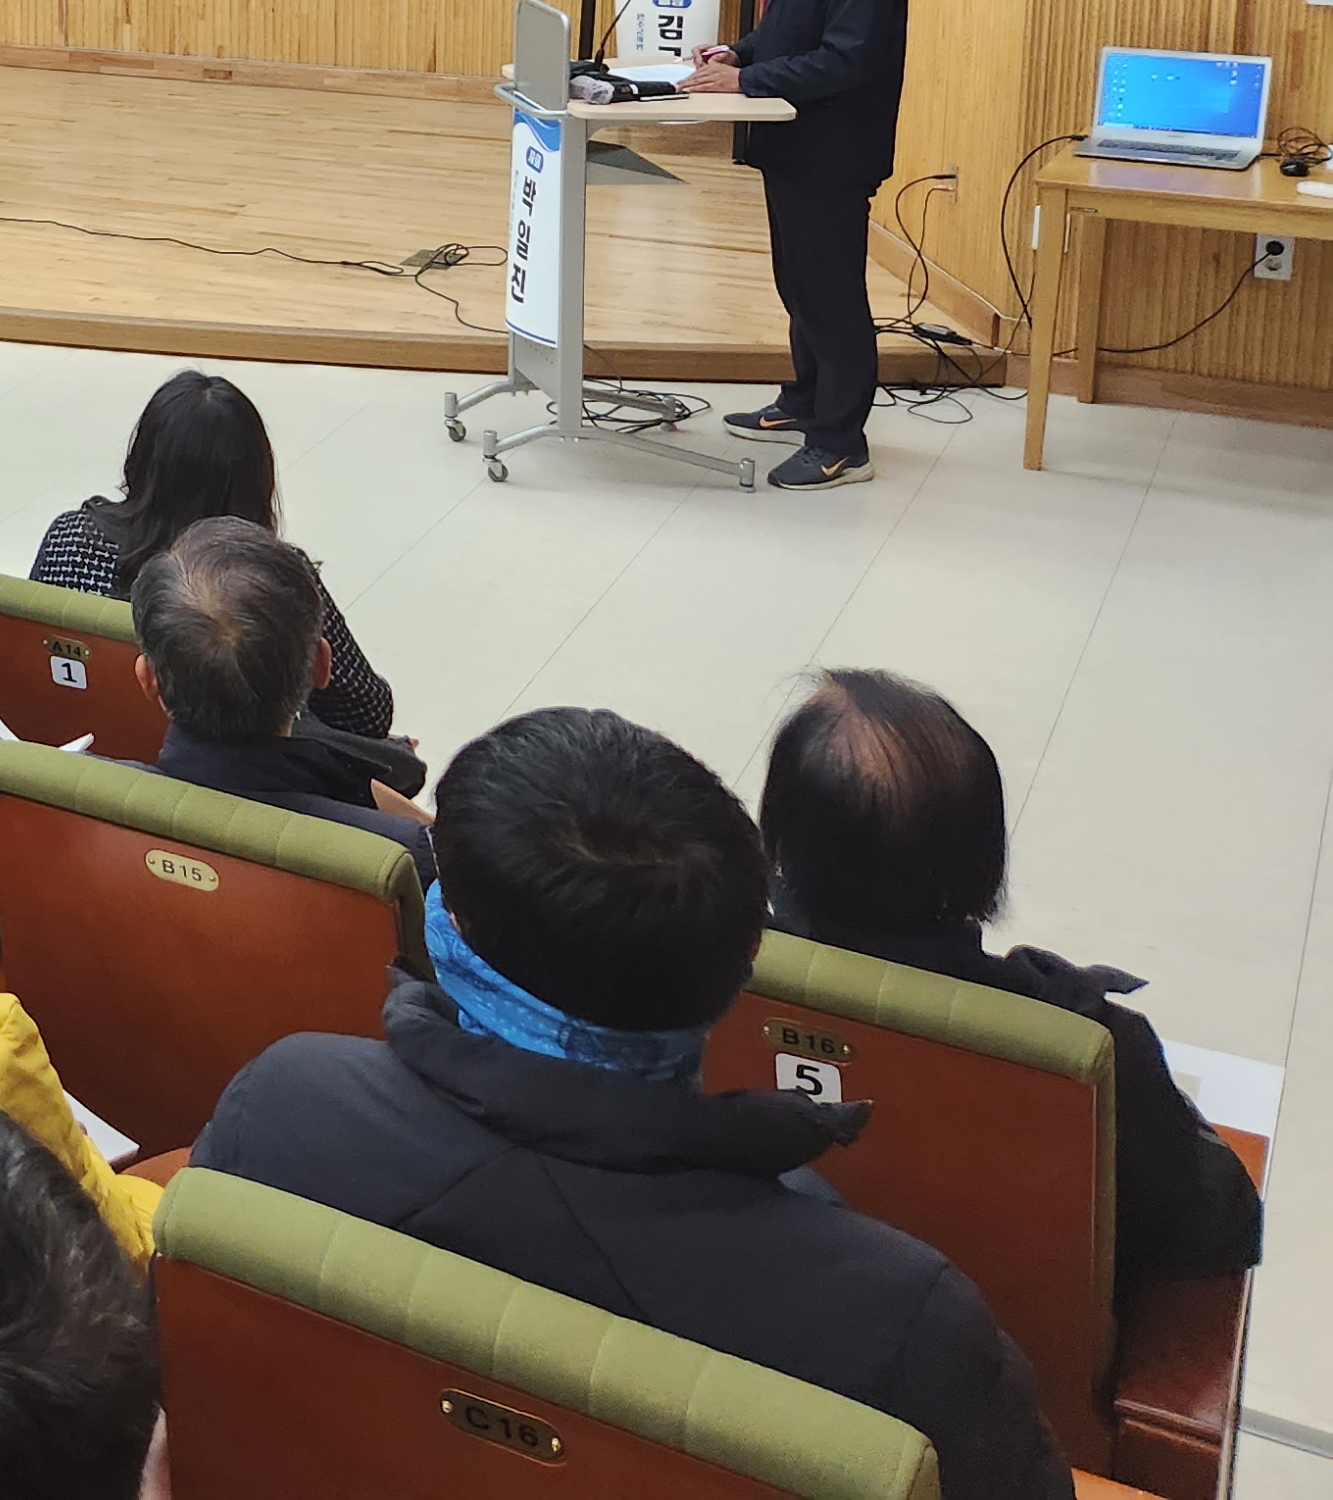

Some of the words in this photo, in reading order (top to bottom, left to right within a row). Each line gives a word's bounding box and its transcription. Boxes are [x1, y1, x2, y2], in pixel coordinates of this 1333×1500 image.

[511, 175, 538, 304] 박일진
[52, 641, 81, 657] A14
[61, 662, 78, 683] 1
[162, 859, 202, 882] B15
[782, 1027, 835, 1054] B16
[795, 1064, 823, 1095] 5
[465, 1405, 540, 1448] C16
